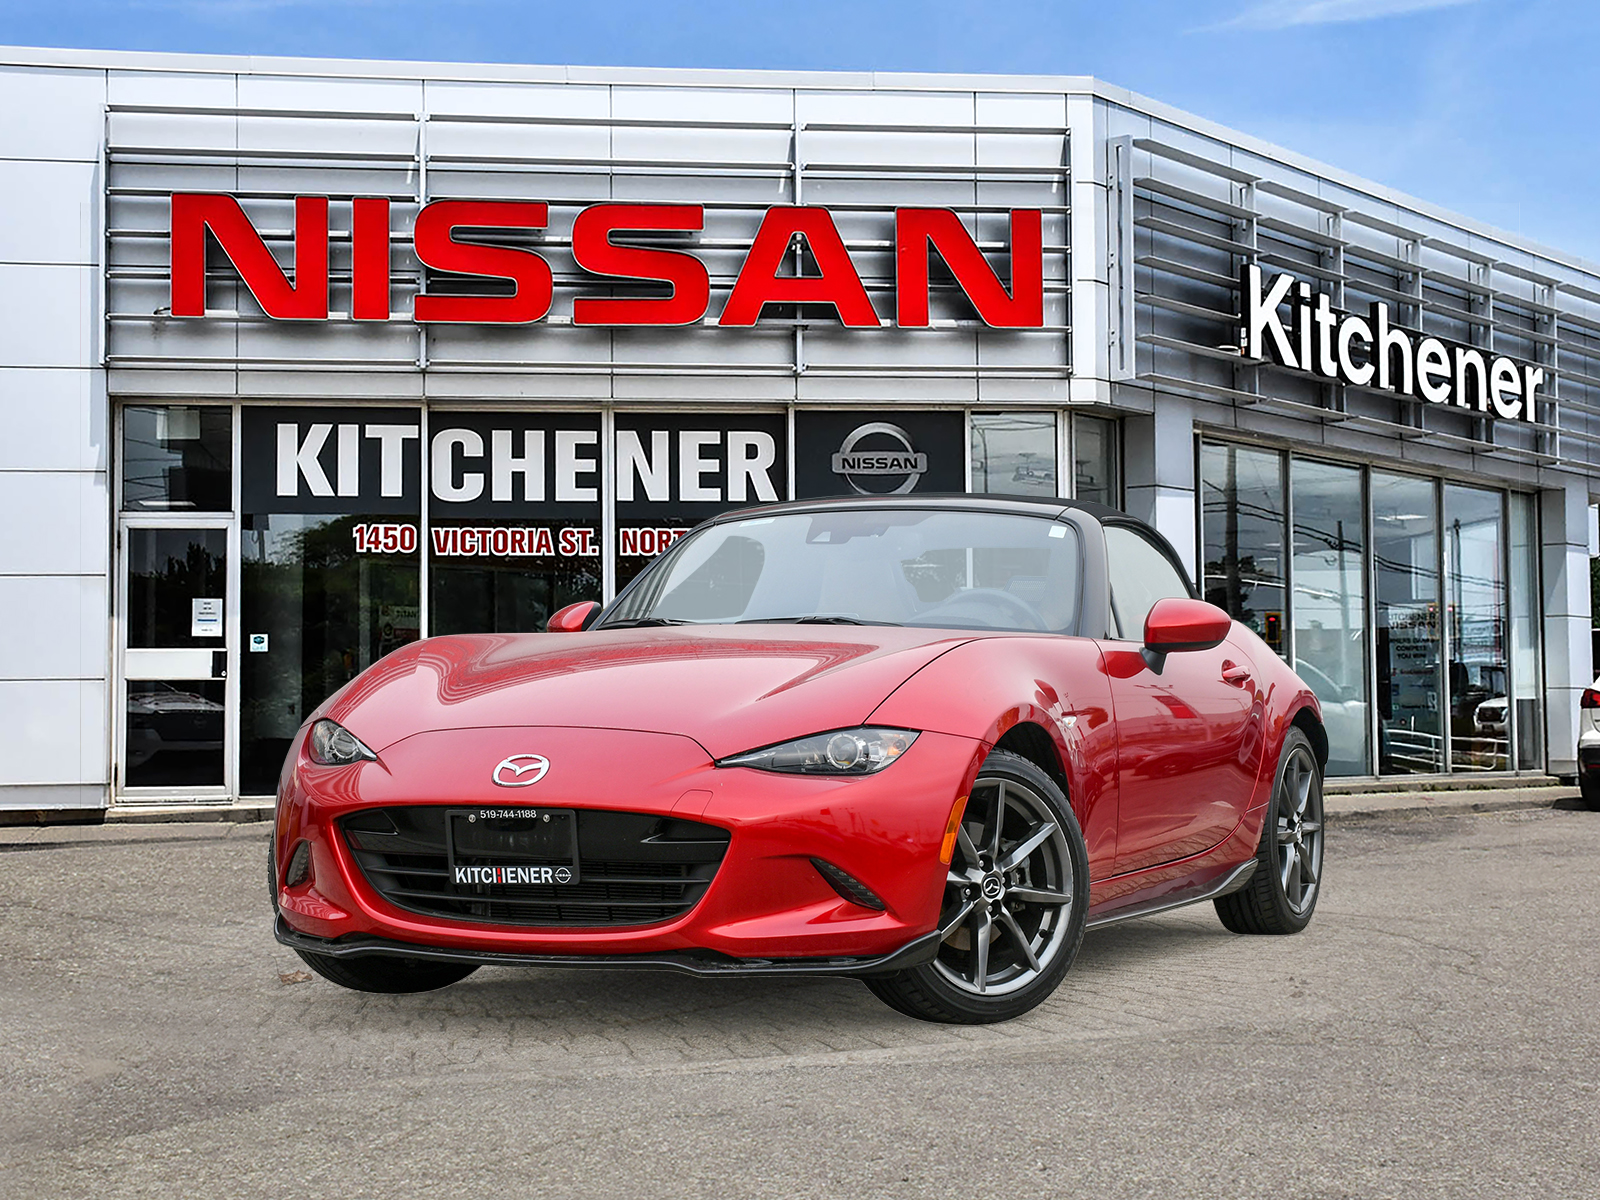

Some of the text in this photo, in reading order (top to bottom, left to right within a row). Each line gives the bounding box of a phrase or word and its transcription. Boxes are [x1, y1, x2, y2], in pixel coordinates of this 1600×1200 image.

[170, 192, 1044, 328] NISSAN
[1242, 263, 1545, 424] Kitchener
[276, 423, 777, 503] KITCHENER
[841, 457, 919, 470] NISSAN
[352, 524, 693, 556] 1450 VICTORIA ST. NORT
[480, 809, 537, 819] 519-744-1188
[455, 867, 553, 884] KITCHENER
